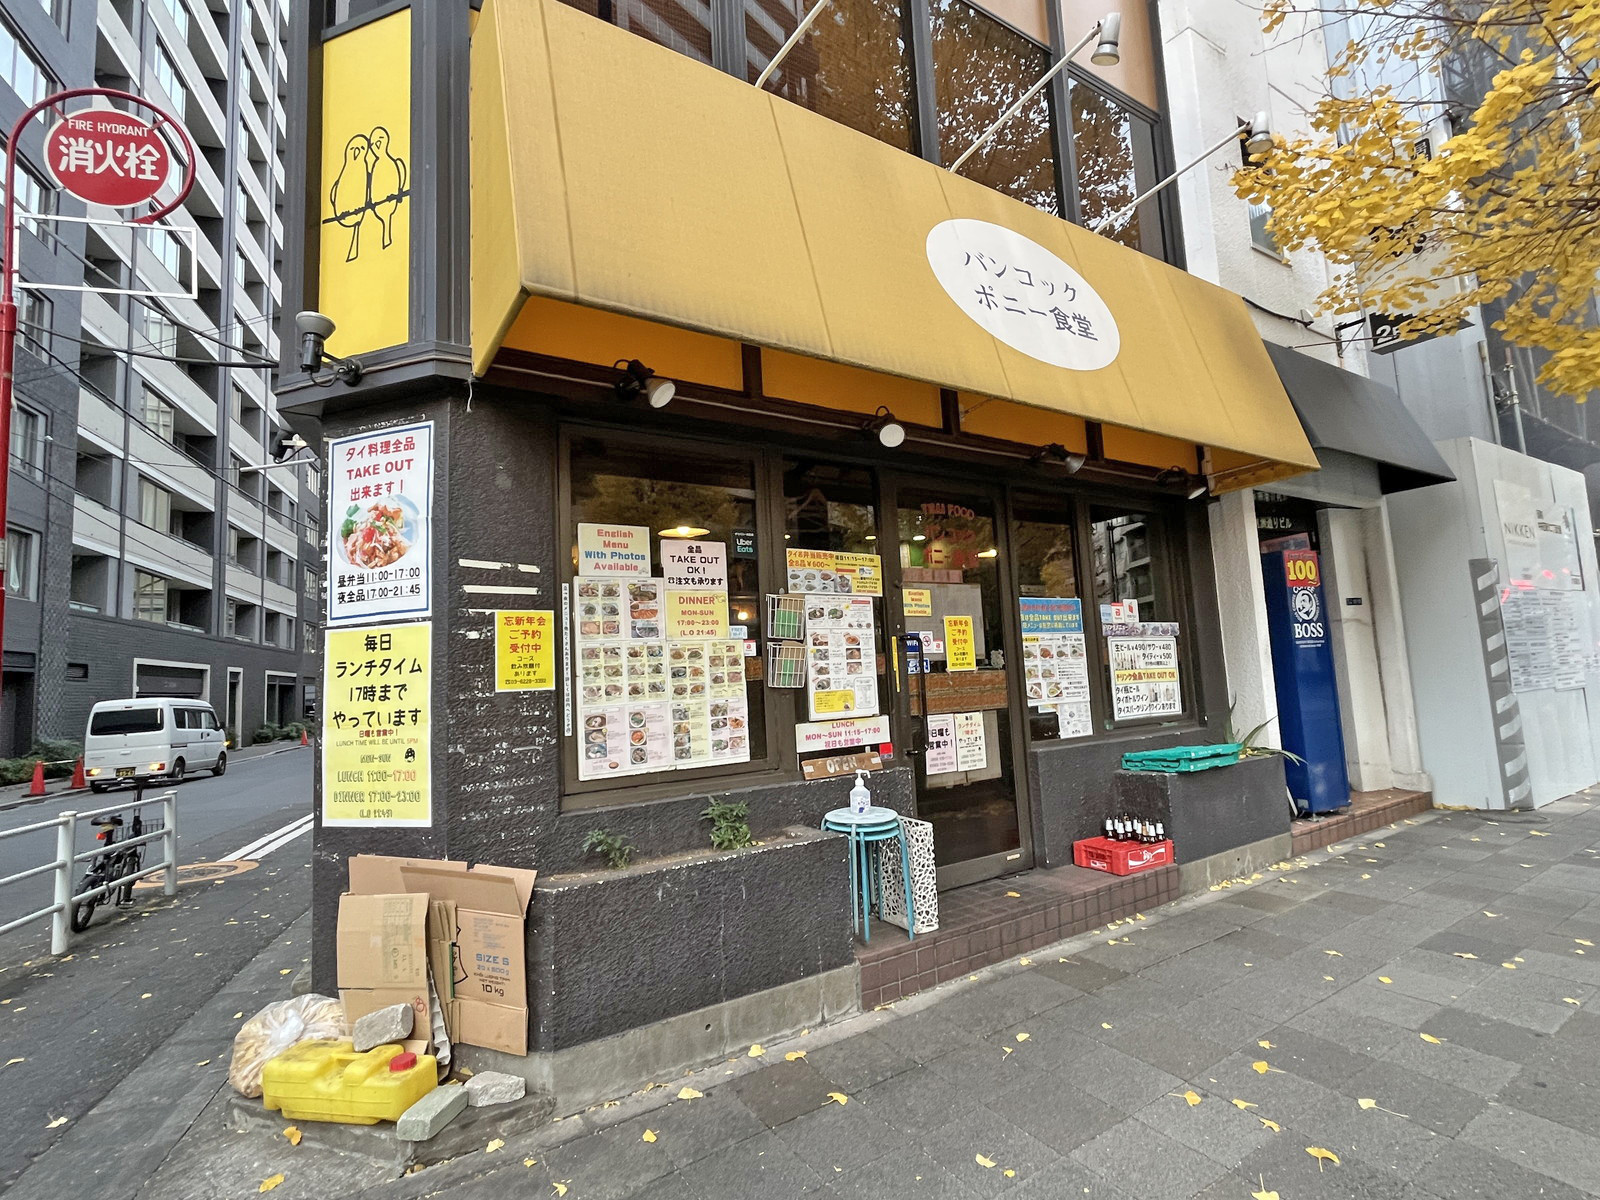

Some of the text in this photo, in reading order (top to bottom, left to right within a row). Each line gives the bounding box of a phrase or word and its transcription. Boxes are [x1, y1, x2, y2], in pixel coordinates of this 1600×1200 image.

[68, 119, 149, 137] FIRE HYDRANT
[58, 135, 161, 181] 消火栓
[964, 251, 1077, 302] バンコック
[974, 284, 1098, 342] ポニー食堂
[345, 436, 416, 462] タイ料理全品
[346, 458, 414, 481] TAKE OUT
[350, 479, 404, 502] 出来ます！
[597, 528, 634, 539] English
[1504, 522, 1536, 539] NIKKEN
[603, 540, 629, 550] Menu
[736, 538, 753, 546] Uber
[687, 545, 702, 554] 全品
[737, 545, 754, 553] Eats
[584, 550, 646, 562] With Photos
[670, 555, 720, 565] TAKE OUT
[593, 562, 639, 572] Available
[1287, 560, 1316, 581] 100
[337, 566, 421, 588] 昼弁当11:00-17:00
[337, 583, 421, 604] 夜全品17:00-21:45
[678, 596, 716, 606] DINNER
[681, 609, 715, 617] MON-SUN
[503, 616, 546, 627] 忘新年会
[509, 629, 542, 640] ご予約
[696, 629, 717, 638] 21:45)
[1294, 623, 1324, 638] BOSS
[364, 633, 392, 653] 毎日
[509, 643, 542, 654] 受付中
[335, 657, 423, 678] ランチタイム
[349, 683, 408, 703] 17時まで
[332, 707, 422, 729] やっています
[832, 721, 855, 729] LUNCH
[931, 728, 950, 738] 日曜も
[336, 739, 354, 747] LUNCH
[390, 737, 405, 745] UNTIL
[826, 756, 858, 774] OPEN
[337, 770, 364, 783] LUNCH
[333, 790, 365, 803] DINNER
[476, 953, 510, 966] SIZE S
[481, 983, 505, 997] 10 kg
